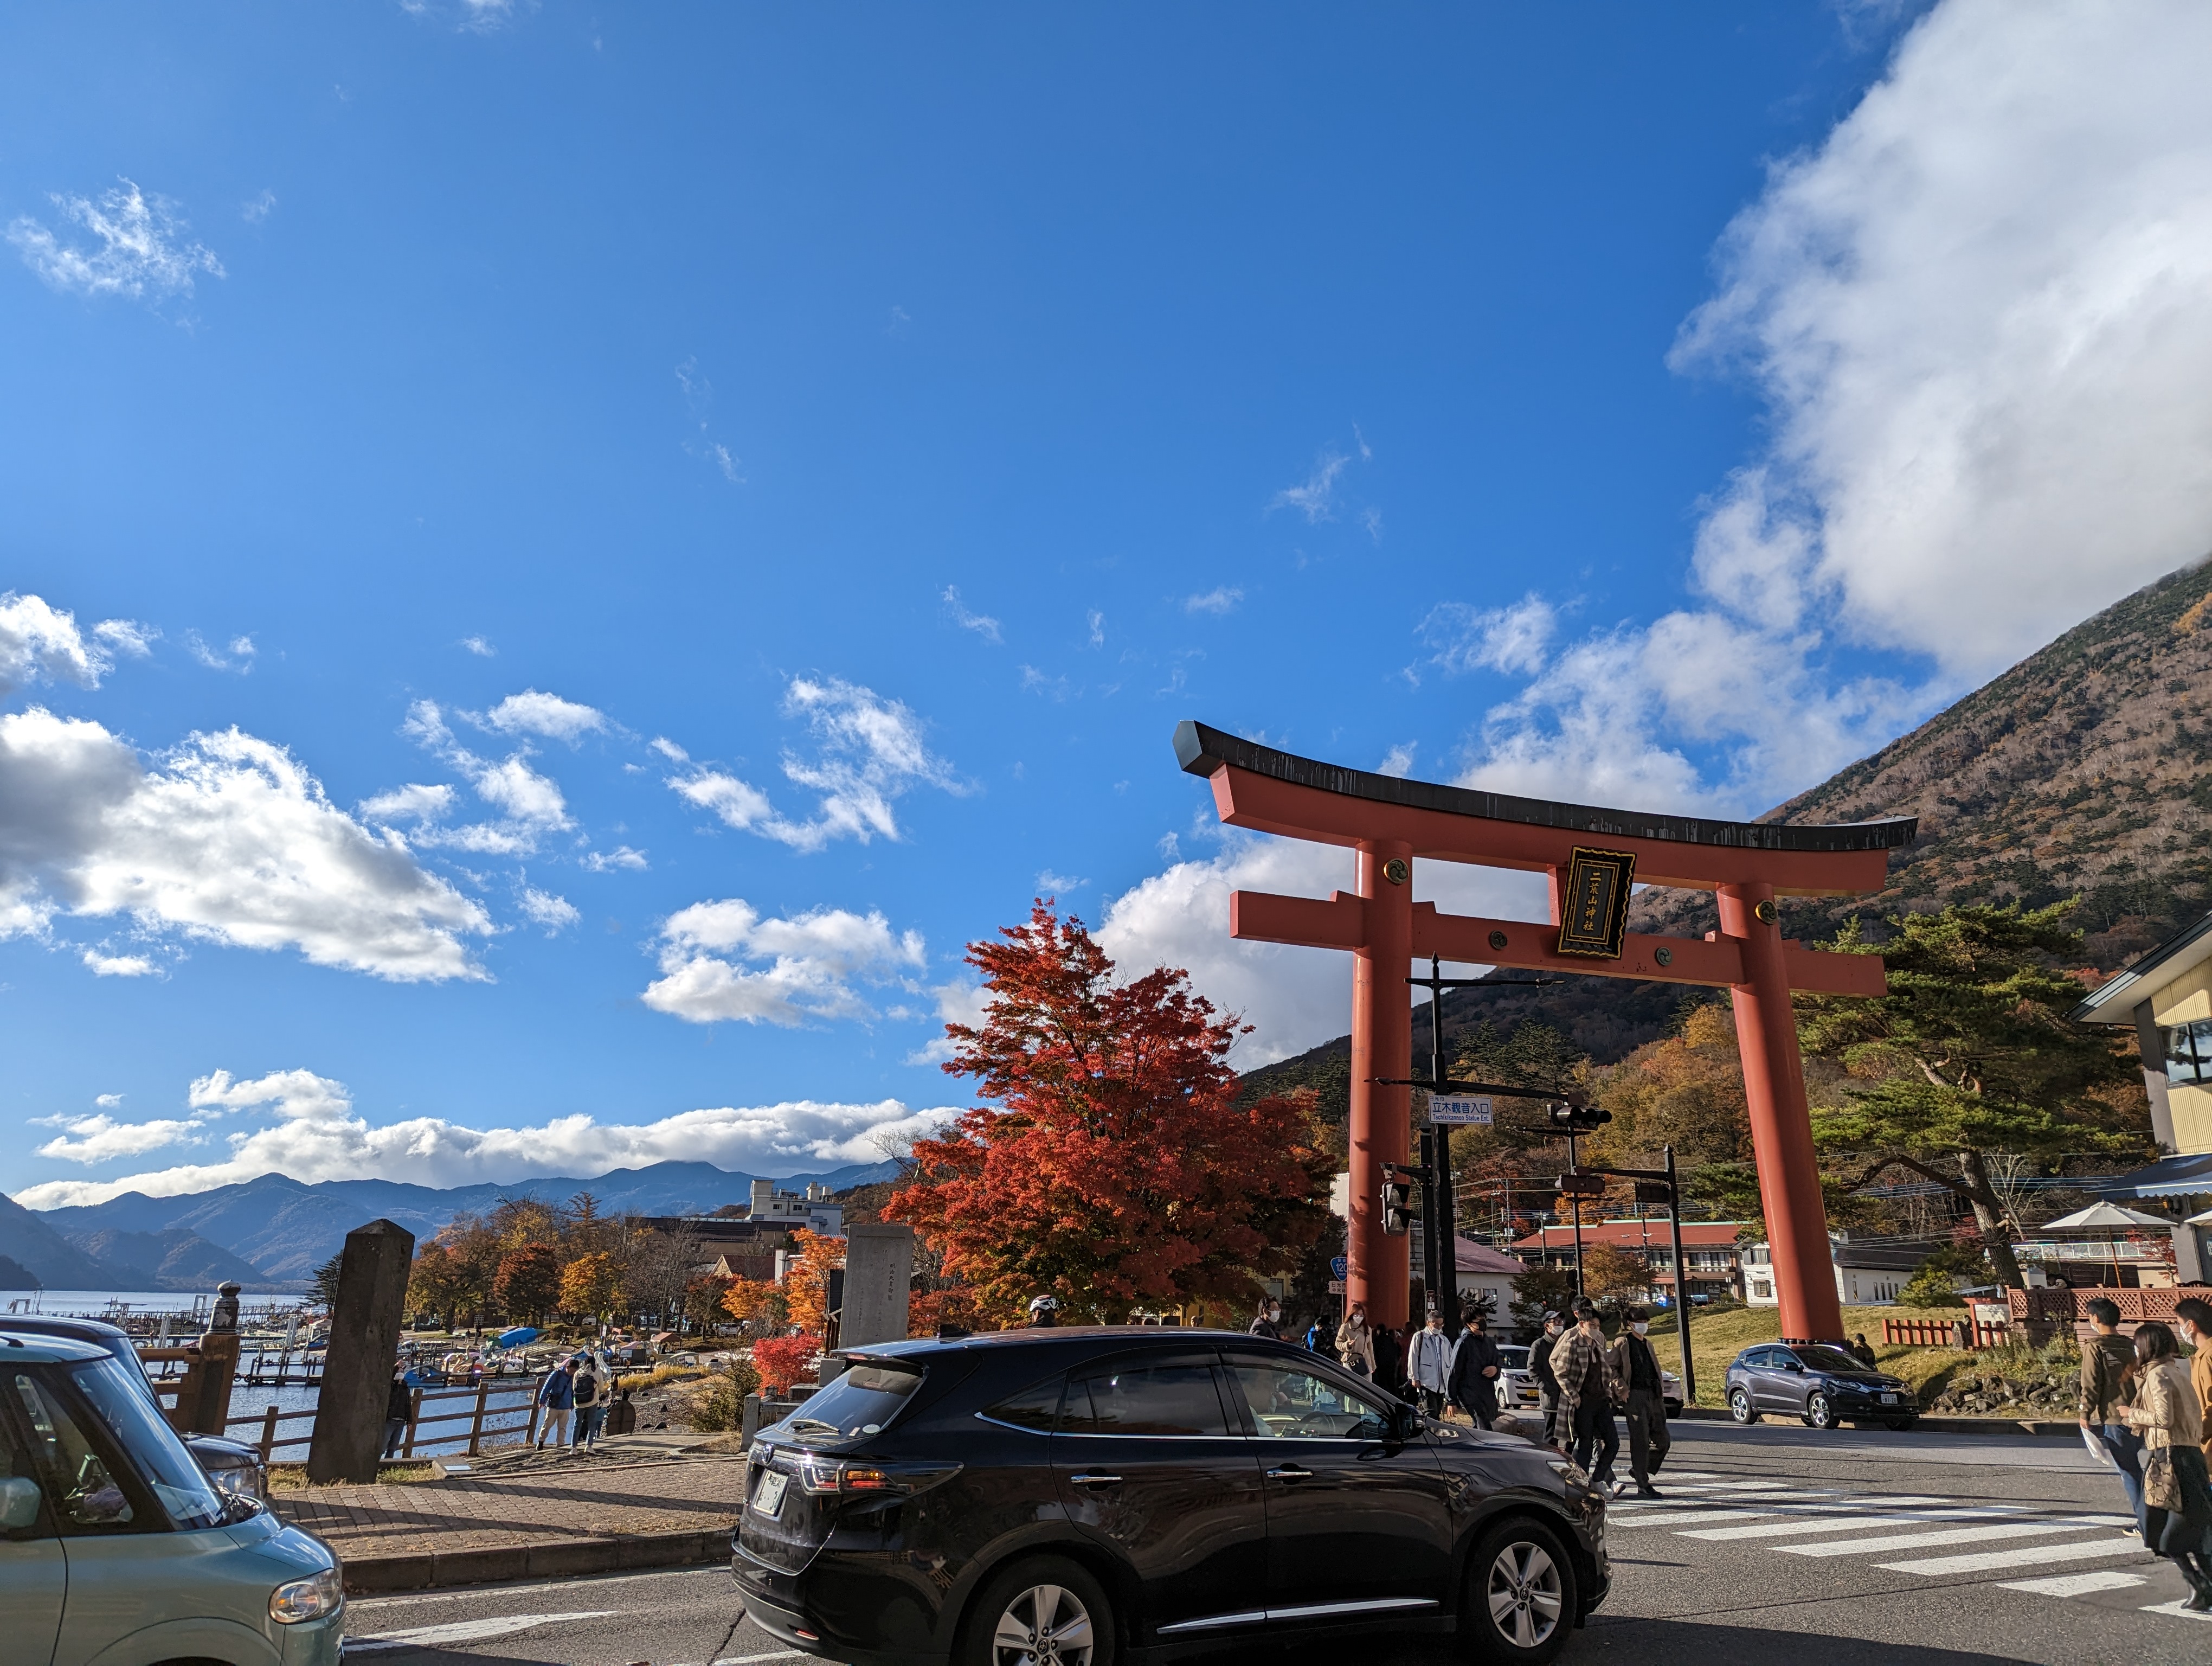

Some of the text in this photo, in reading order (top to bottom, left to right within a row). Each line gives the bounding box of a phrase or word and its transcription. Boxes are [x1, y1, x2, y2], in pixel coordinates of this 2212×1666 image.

[1583, 872, 1602, 931] 二荒山神社
[1432, 1102, 1489, 1113] 立木観音入口
[1336, 1263, 1348, 1272] 120
